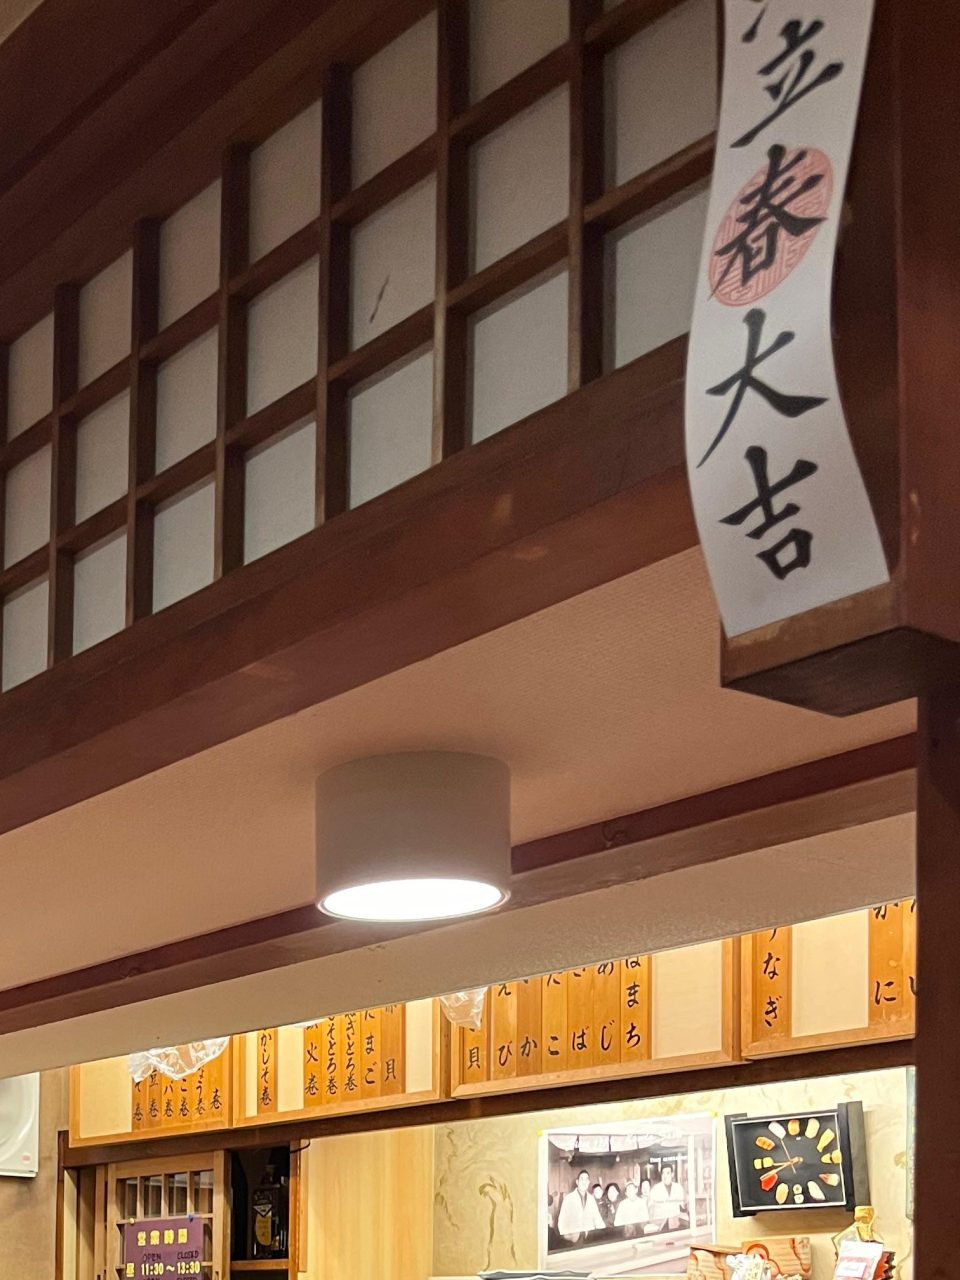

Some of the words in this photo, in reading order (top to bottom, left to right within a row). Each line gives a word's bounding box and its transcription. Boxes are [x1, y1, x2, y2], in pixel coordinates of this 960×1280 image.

[697, 0, 844, 580] 立春大吉
[763, 928, 782, 1027] なぎ
[305, 1024, 319, 1096] 火巻
[326, 1016, 338, 1095] そとろ巻
